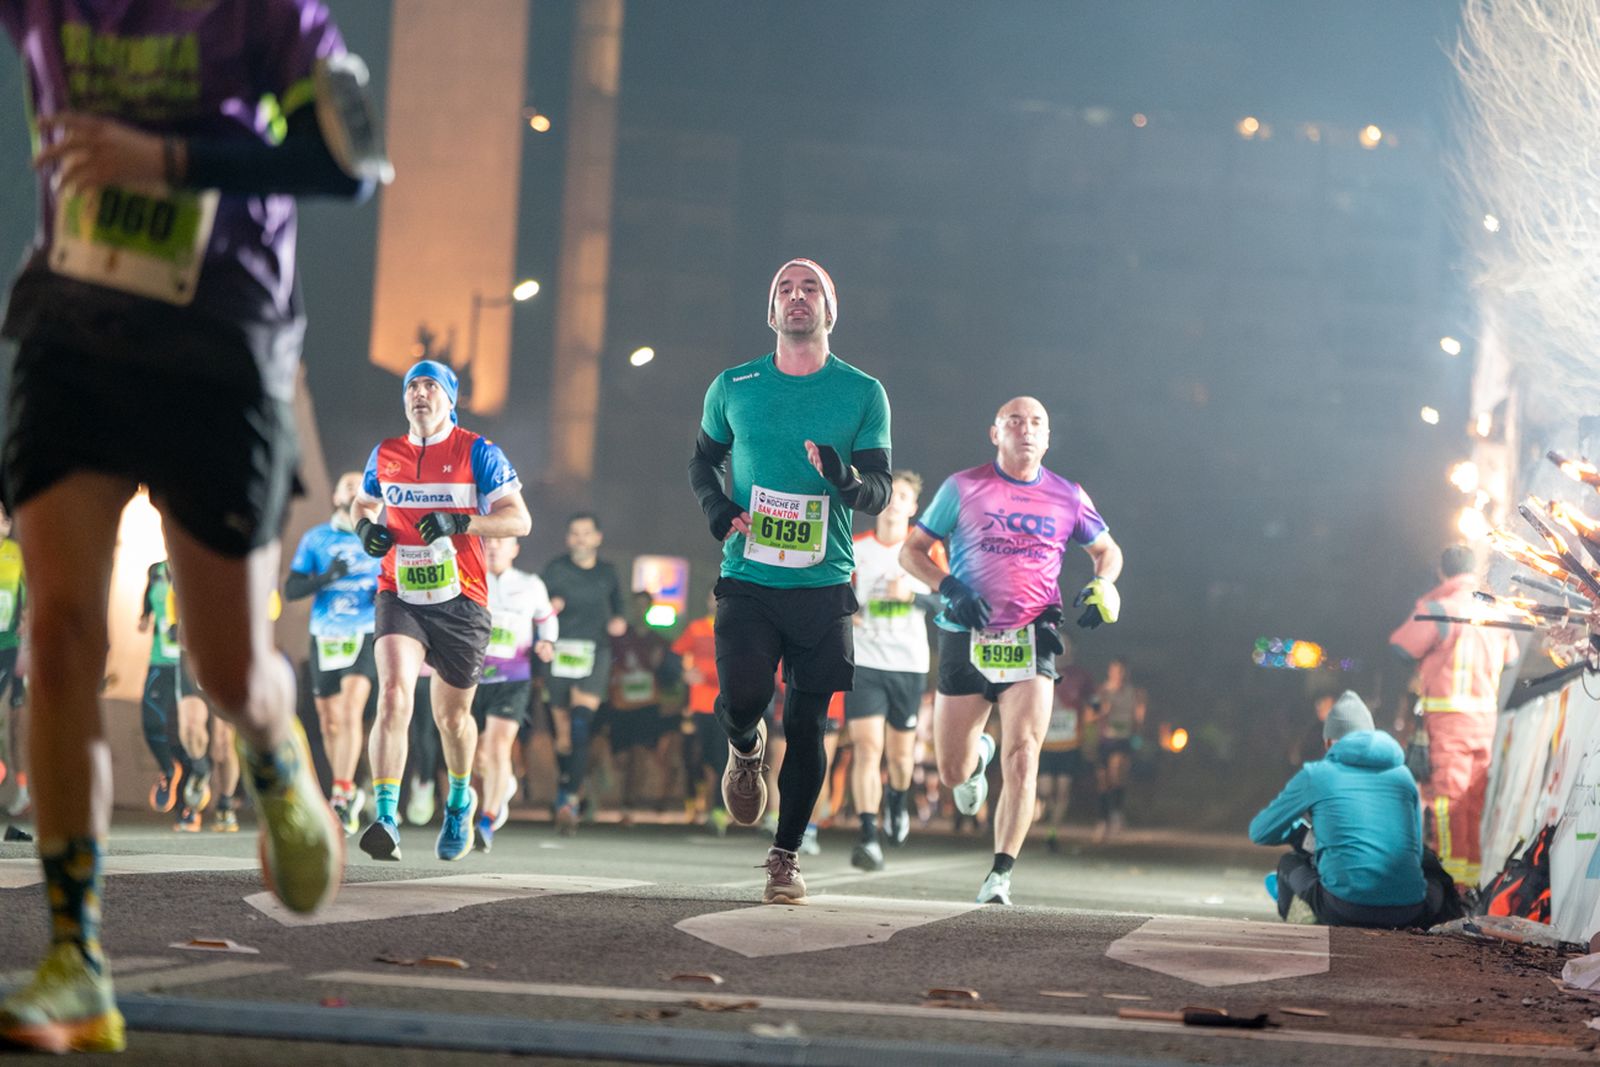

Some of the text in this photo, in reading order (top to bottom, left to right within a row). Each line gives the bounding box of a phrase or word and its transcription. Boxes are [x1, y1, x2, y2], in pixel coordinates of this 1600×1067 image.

[405, 490, 453, 502] Avanza
[758, 505, 772, 515] SAN
[789, 502, 800, 511] DE
[761, 517, 811, 543] 6139
[407, 564, 445, 584] 4687
[983, 645, 1024, 663] 5999
